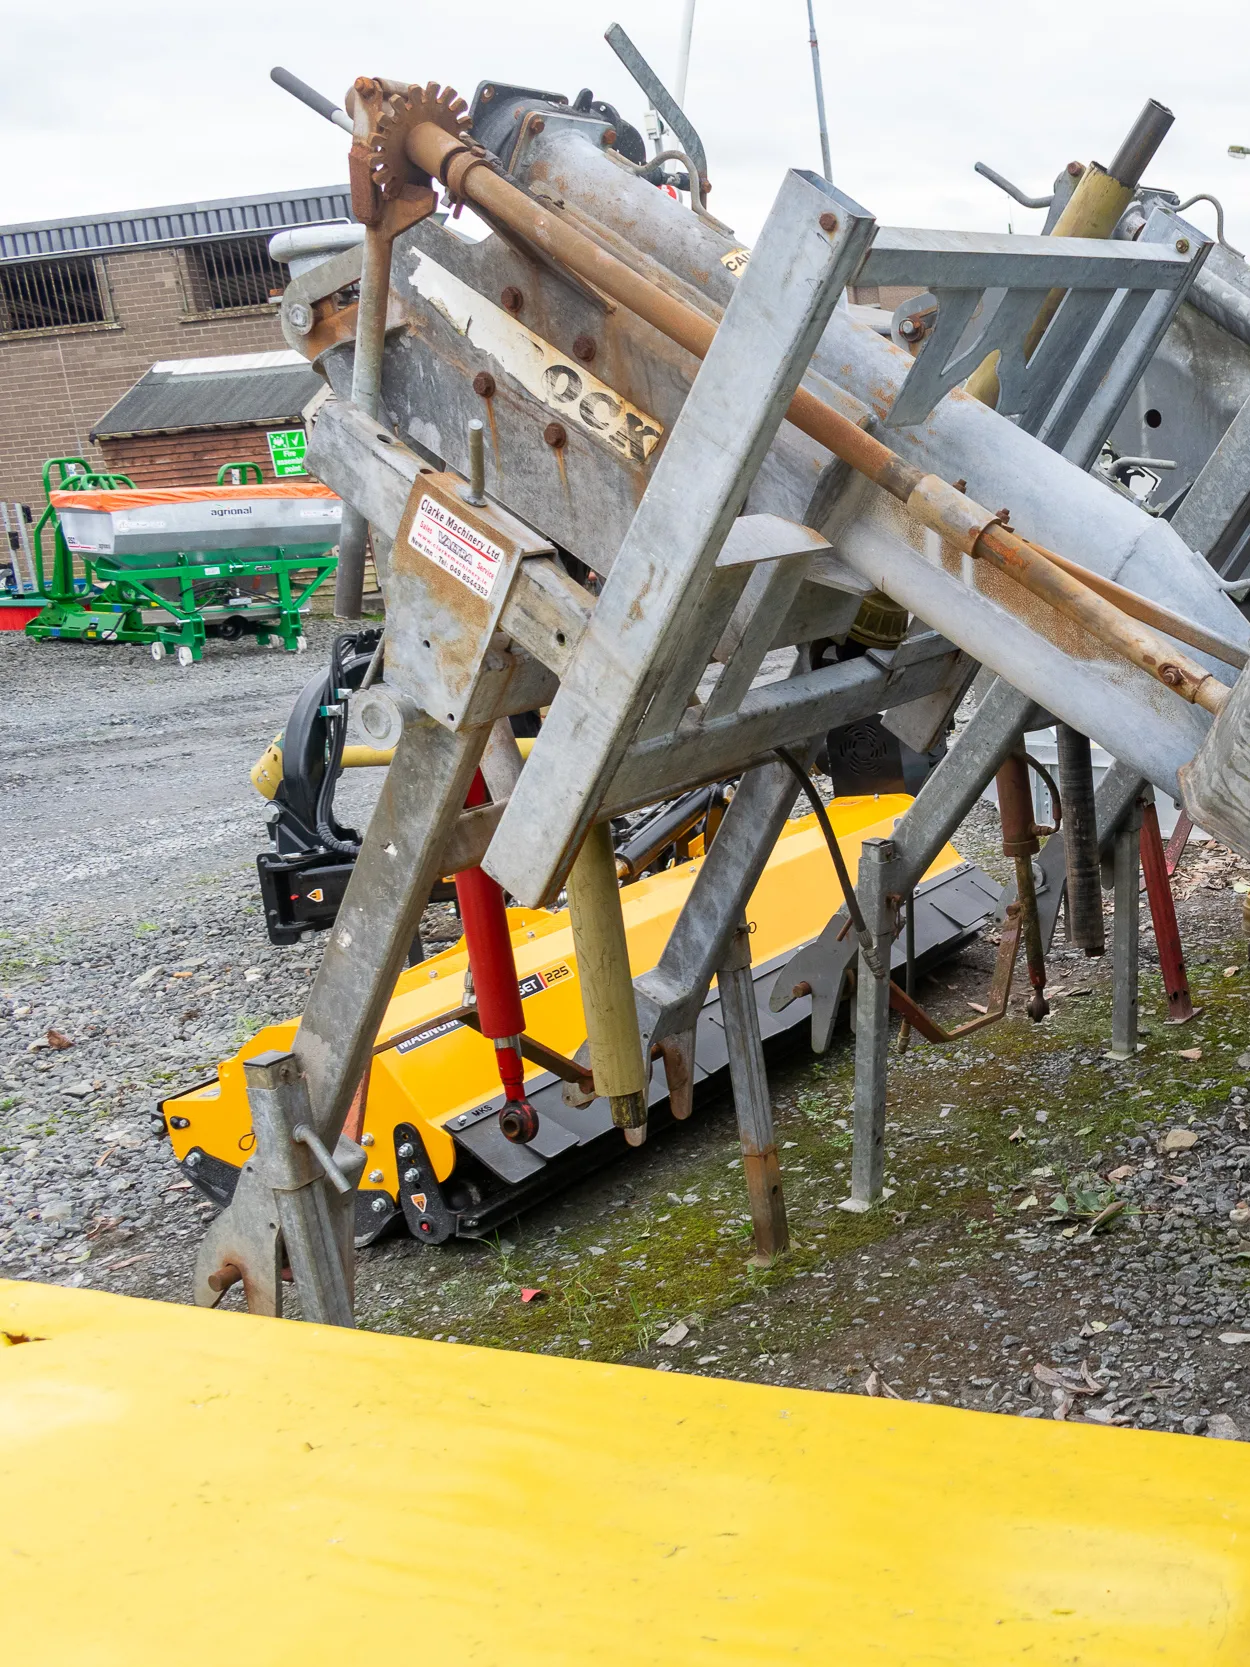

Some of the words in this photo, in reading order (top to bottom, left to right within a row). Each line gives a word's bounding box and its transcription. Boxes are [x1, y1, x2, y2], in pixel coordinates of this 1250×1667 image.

[540, 363, 662, 461] OCK
[210, 505, 252, 516] agrional
[420, 499, 444, 522] Clarke
[445, 516, 487, 550] Machinery
[486, 545, 501, 562] Ltd.
[411, 536, 422, 549] New
[423, 545, 434, 557] Inn
[449, 564, 461, 577] 049
[419, 520, 433, 534] Sales
[438, 530, 473, 565] VALTRA
[476, 562, 495, 580] Service
[518, 979, 538, 996] SET
[544, 965, 569, 983] 225
